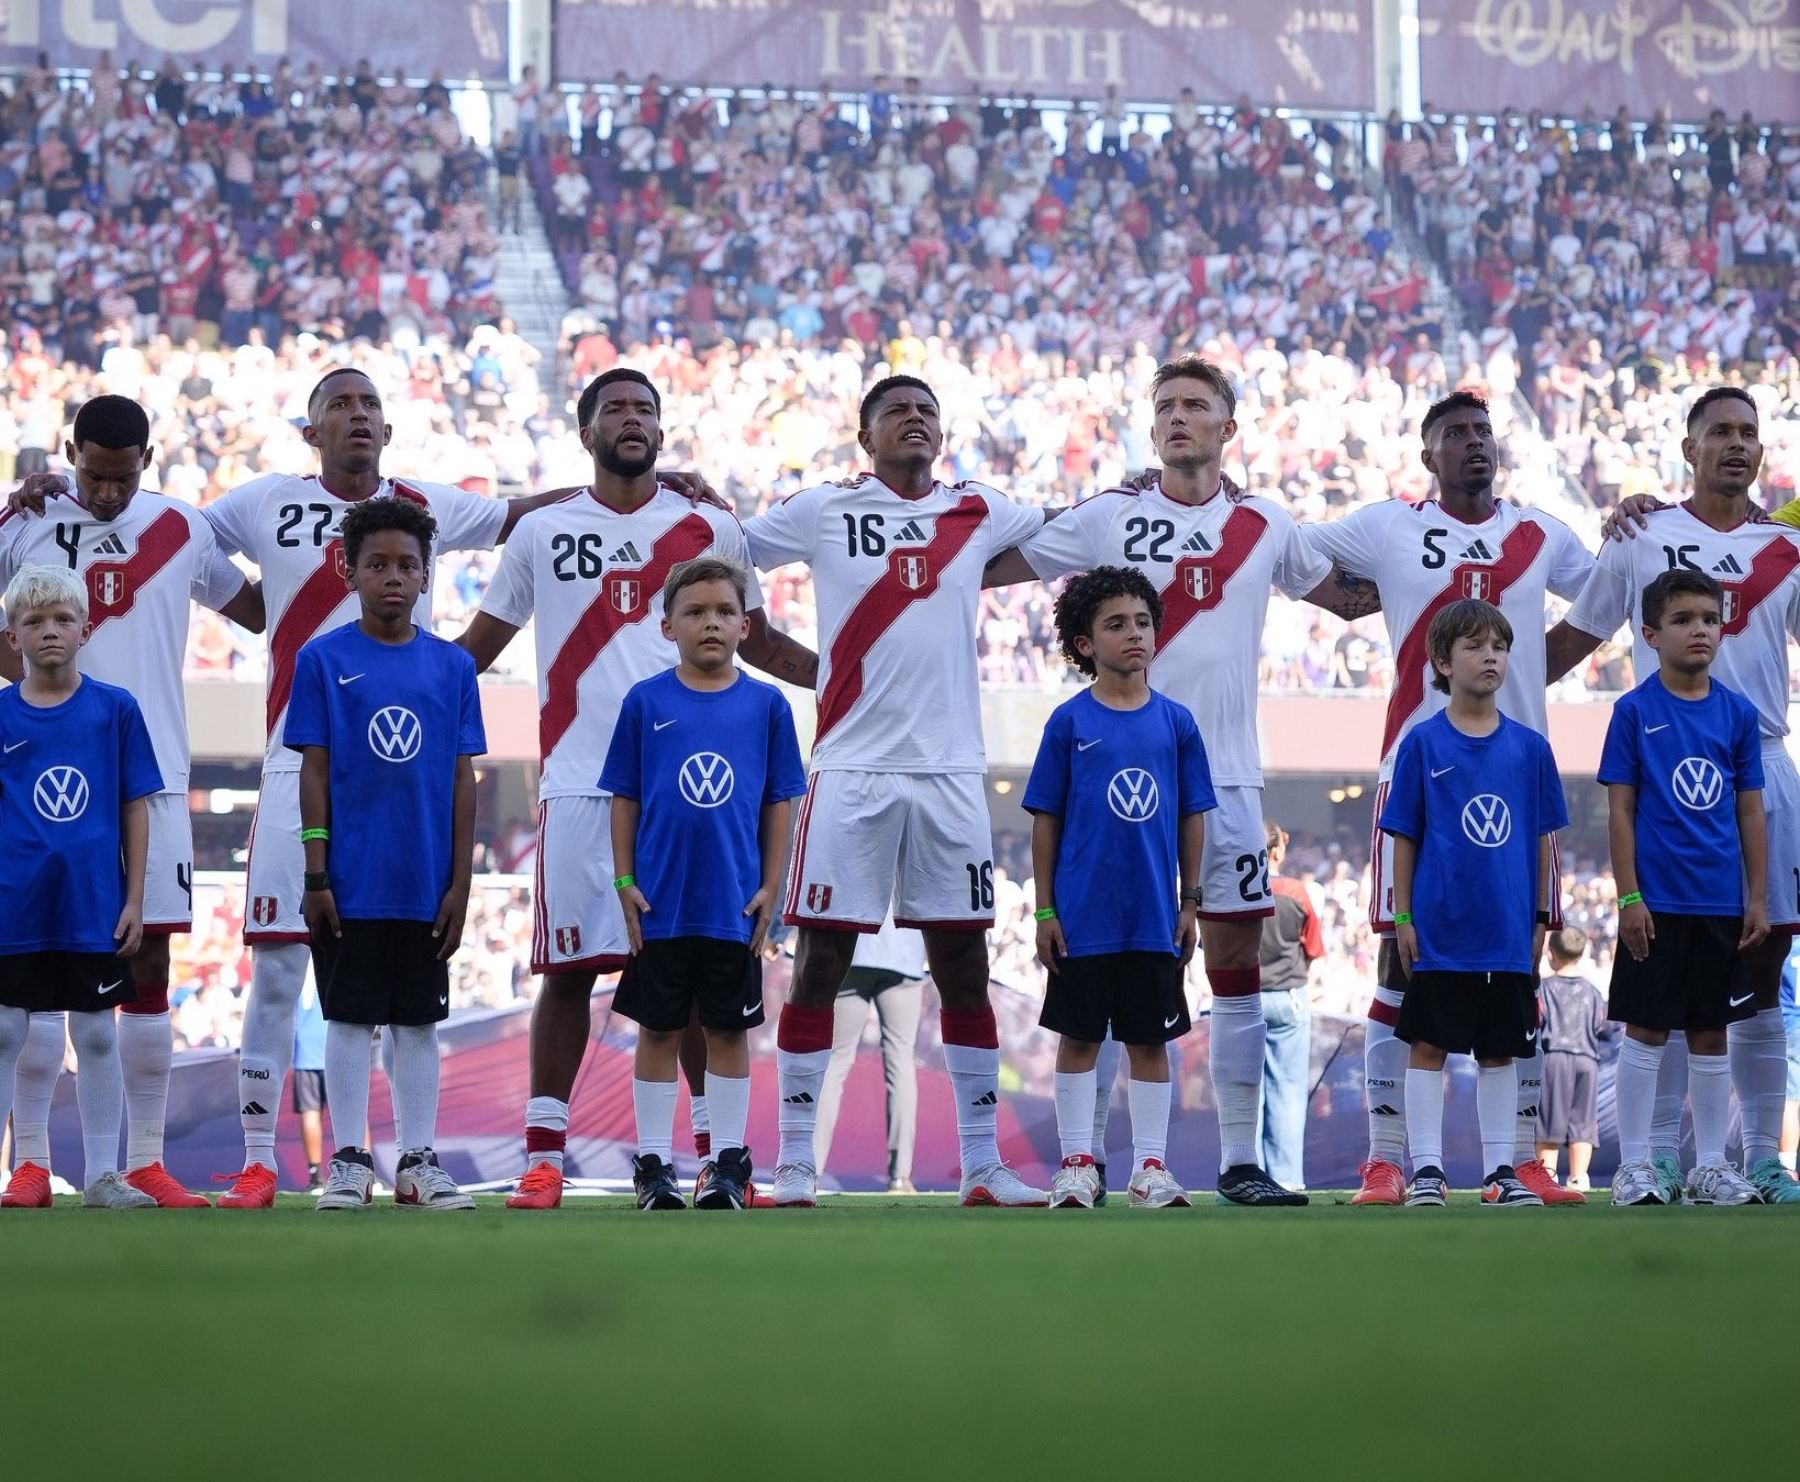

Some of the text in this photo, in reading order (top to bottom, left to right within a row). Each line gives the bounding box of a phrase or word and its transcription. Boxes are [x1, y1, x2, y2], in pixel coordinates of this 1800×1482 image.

[818, 8, 1127, 85] HEALTH
[56, 522, 81, 570] 4
[277, 503, 332, 547] 27
[843, 513, 885, 557] 16
[1124, 517, 1174, 563] 22
[551, 533, 602, 581] 26
[370, 707, 419, 761] VW
[36, 767, 87, 820] VW
[681, 753, 732, 806] VW
[1110, 769, 1156, 820] VW
[1675, 759, 1720, 809] VW
[1464, 795, 1508, 846] VW
[966, 860, 994, 911] 16
[1521, 1078, 1541, 1087] PER
